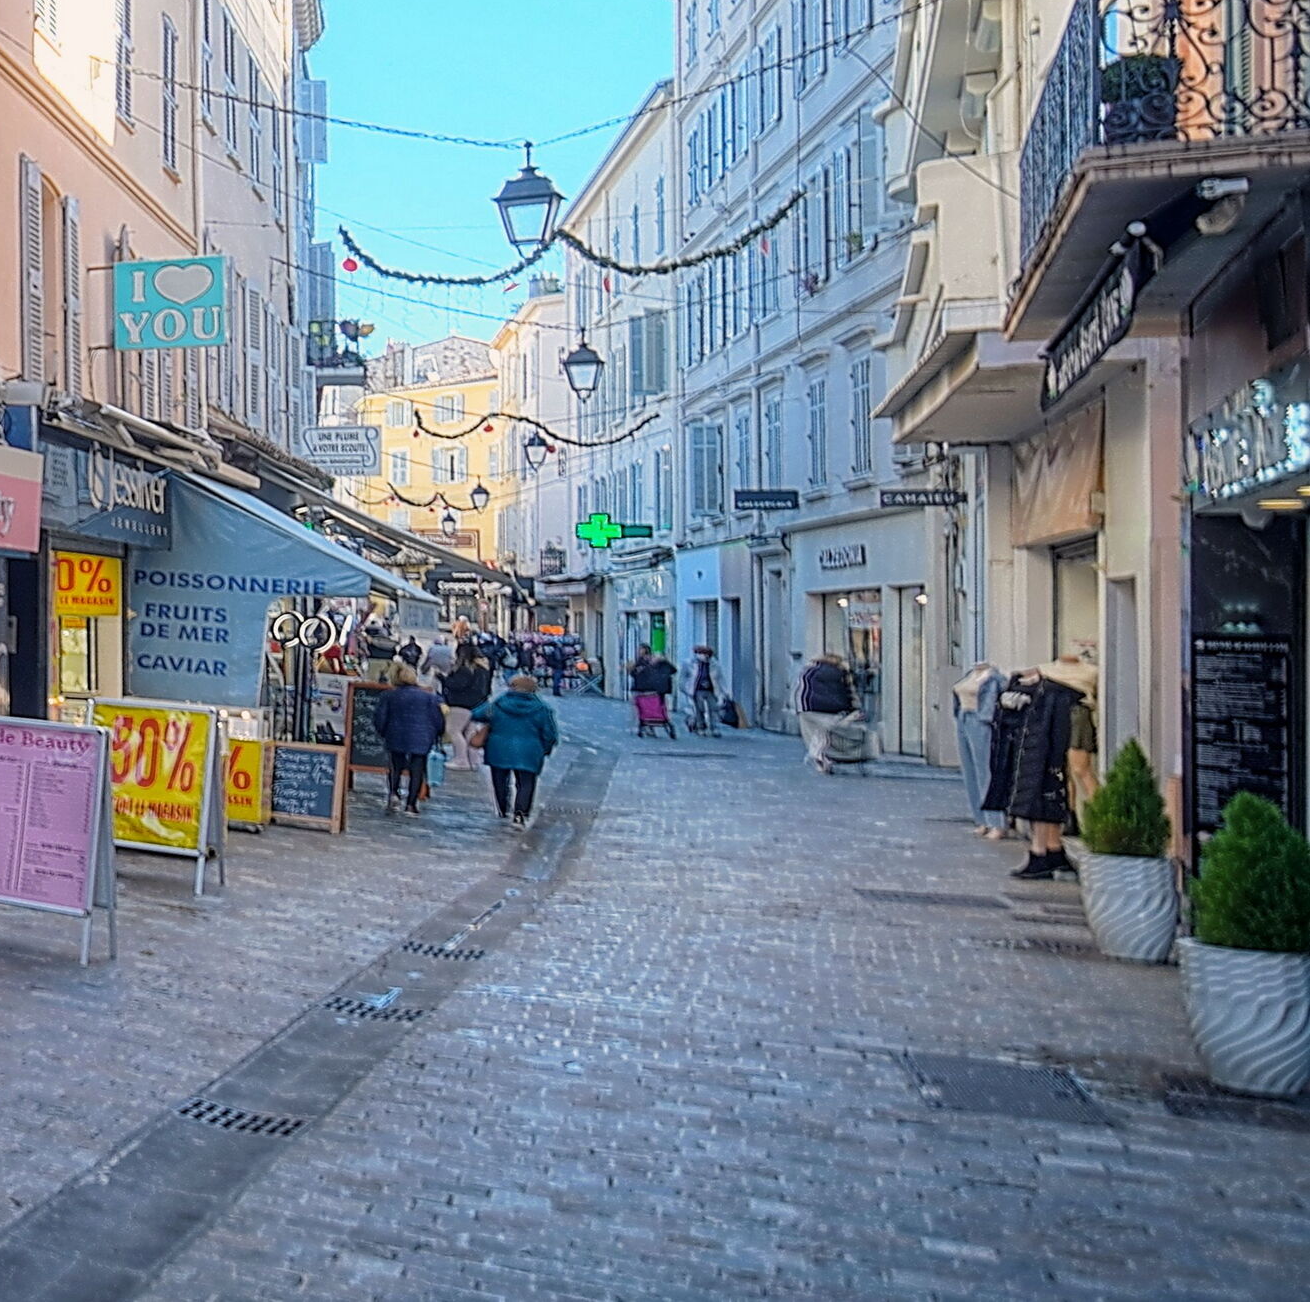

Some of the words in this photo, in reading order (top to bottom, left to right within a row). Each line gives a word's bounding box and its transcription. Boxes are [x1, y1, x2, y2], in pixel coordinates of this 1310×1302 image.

[132, 270, 146, 303] I
[119, 305, 222, 344] YOU
[134, 569, 326, 596] POISSONNERIE
[145, 602, 227, 623] FRUITS
[140, 622, 169, 639] DE
[178, 625, 230, 644] MER
[137, 654, 227, 677] CAVIAR
[21, 730, 90, 756] Beauty
[111, 715, 194, 793] 50%
